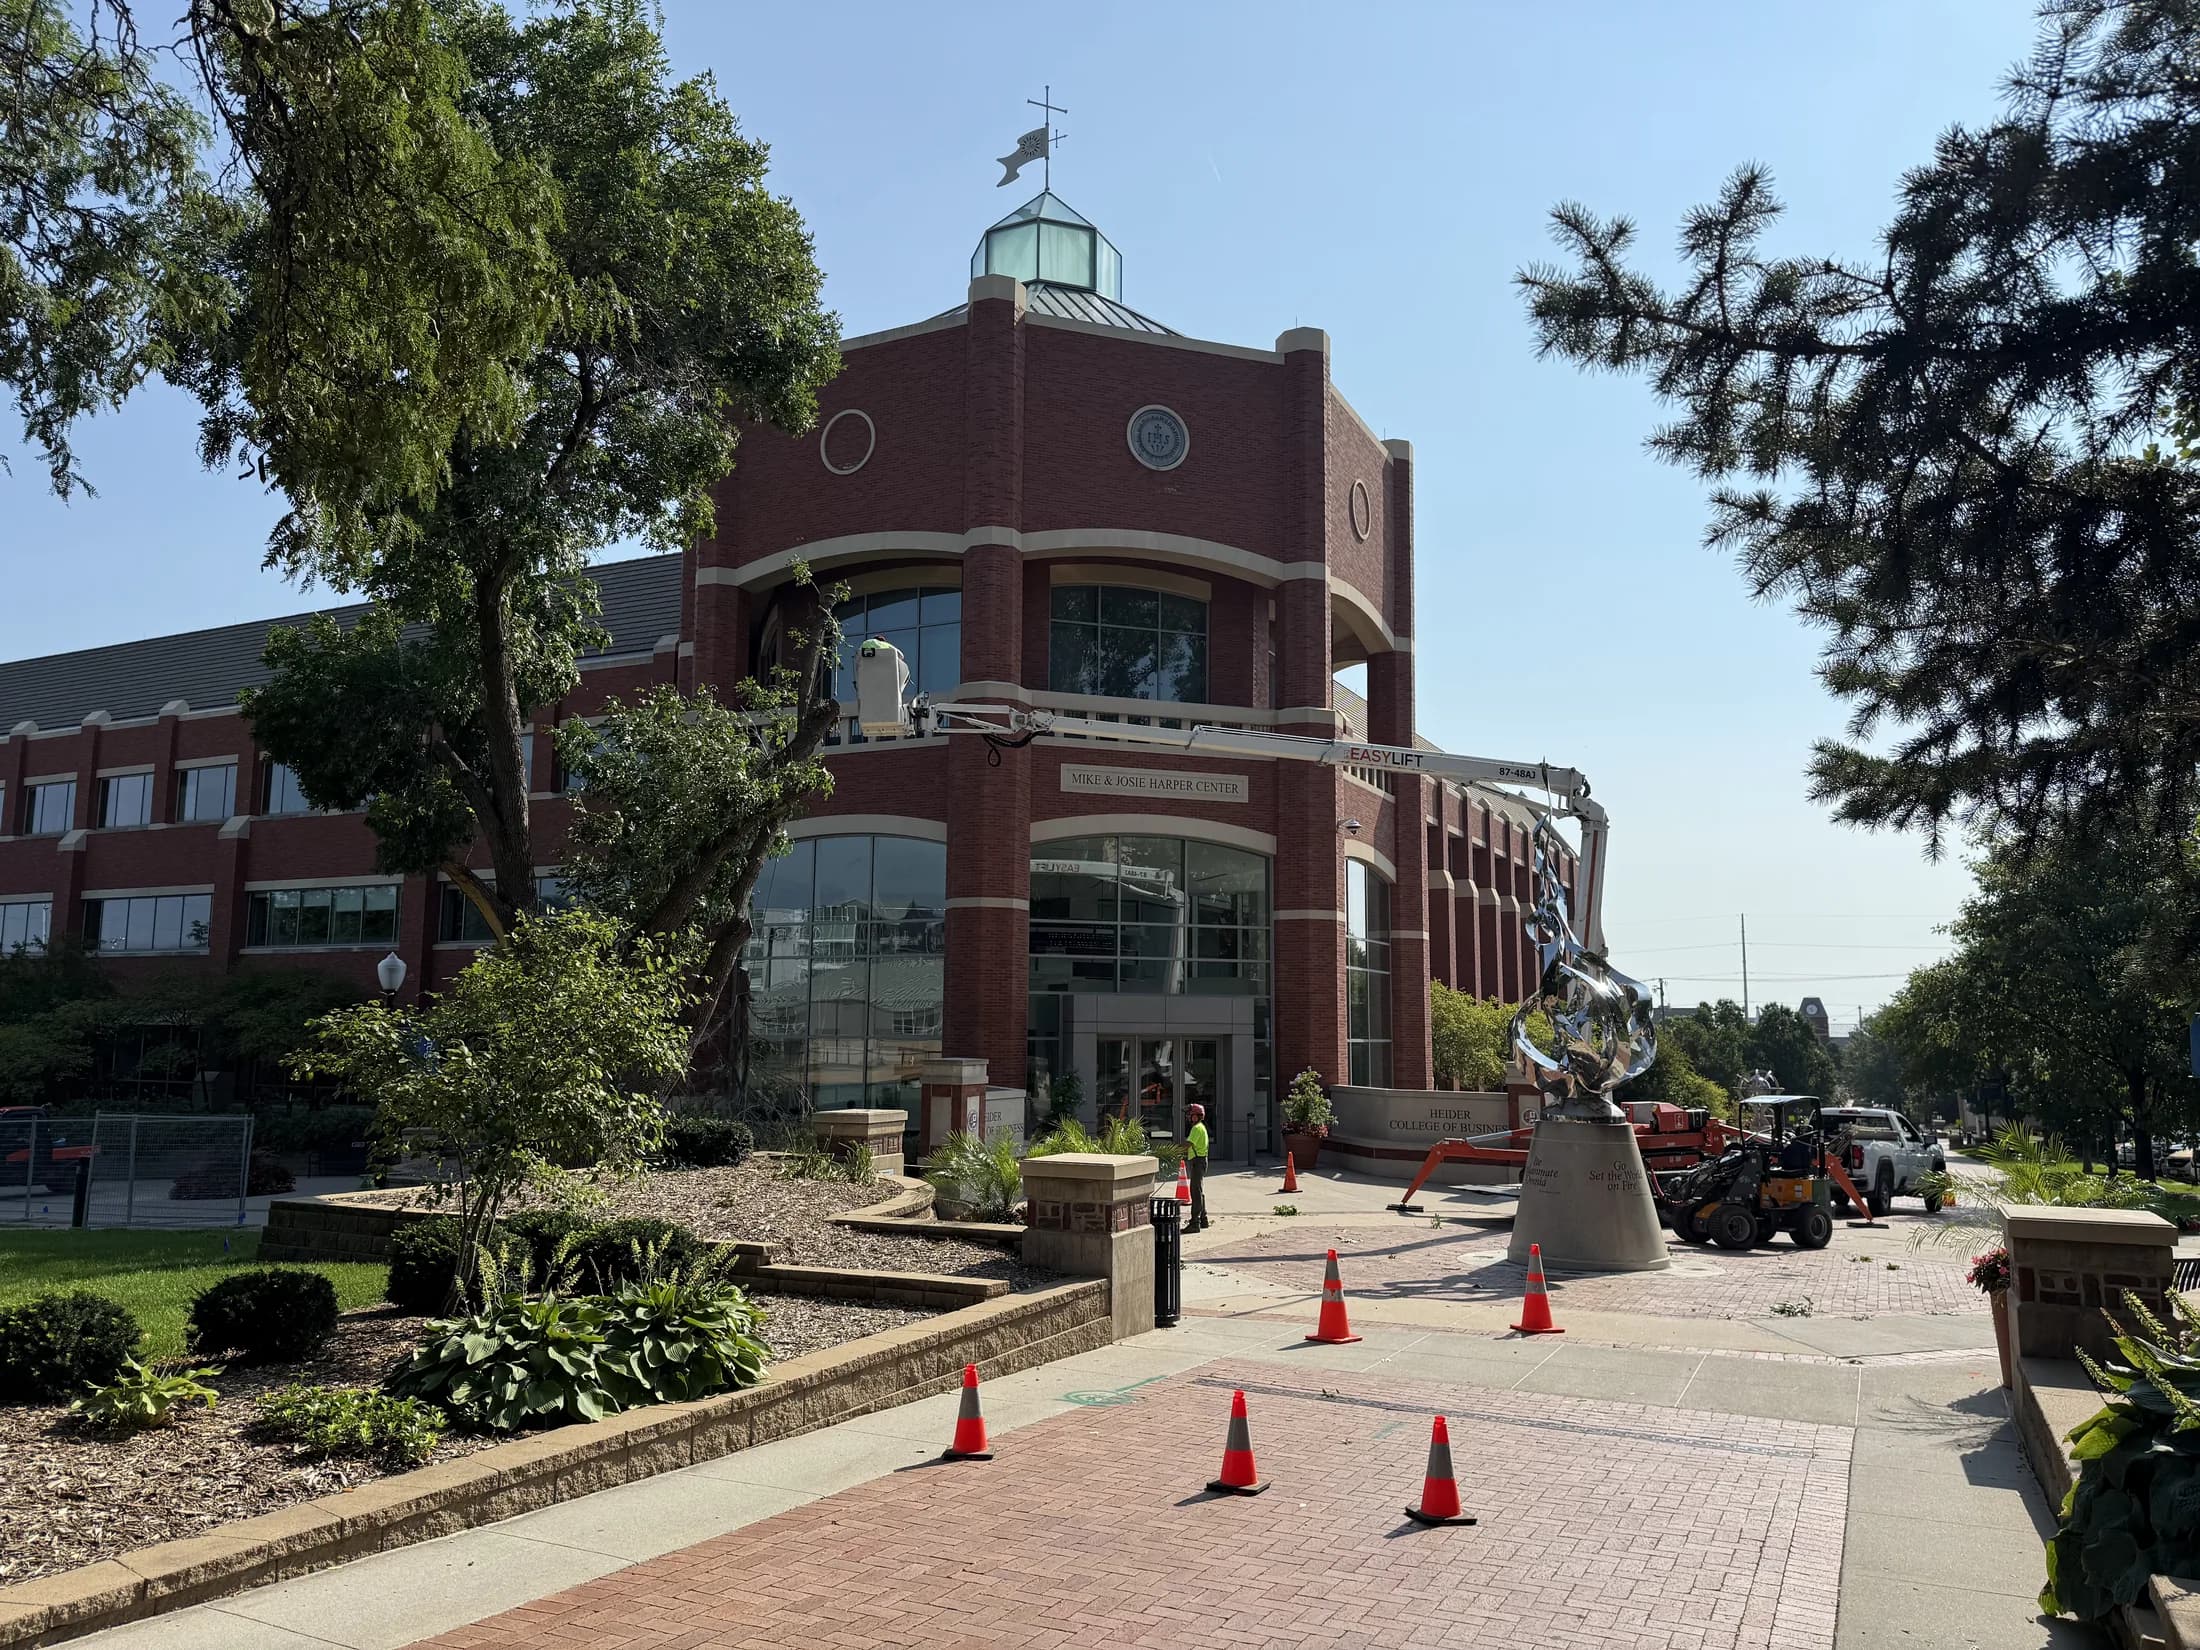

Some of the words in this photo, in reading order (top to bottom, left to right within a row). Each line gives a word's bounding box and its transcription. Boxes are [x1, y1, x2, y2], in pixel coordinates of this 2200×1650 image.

[1349, 747, 1424, 767] EASYLIFT
[1499, 767, 1536, 779] 87-48AJ
[1072, 773, 1101, 785] MIKE
[1104, 776, 1112, 786] &
[1116, 776, 1146, 788] JOSIE
[1149, 778, 1193, 791] HARPER
[1196, 782, 1239, 794] CENTER
[1430, 1109, 1471, 1120] HEIDER
[1389, 1119, 1440, 1132] COLLEGE
[1443, 1122, 1457, 1133] OF
[1613, 1160, 1626, 1171] Go
[1588, 1170, 1604, 1182] Set
[1607, 1170, 1622, 1181] the
[1607, 1181, 1619, 1191] on
